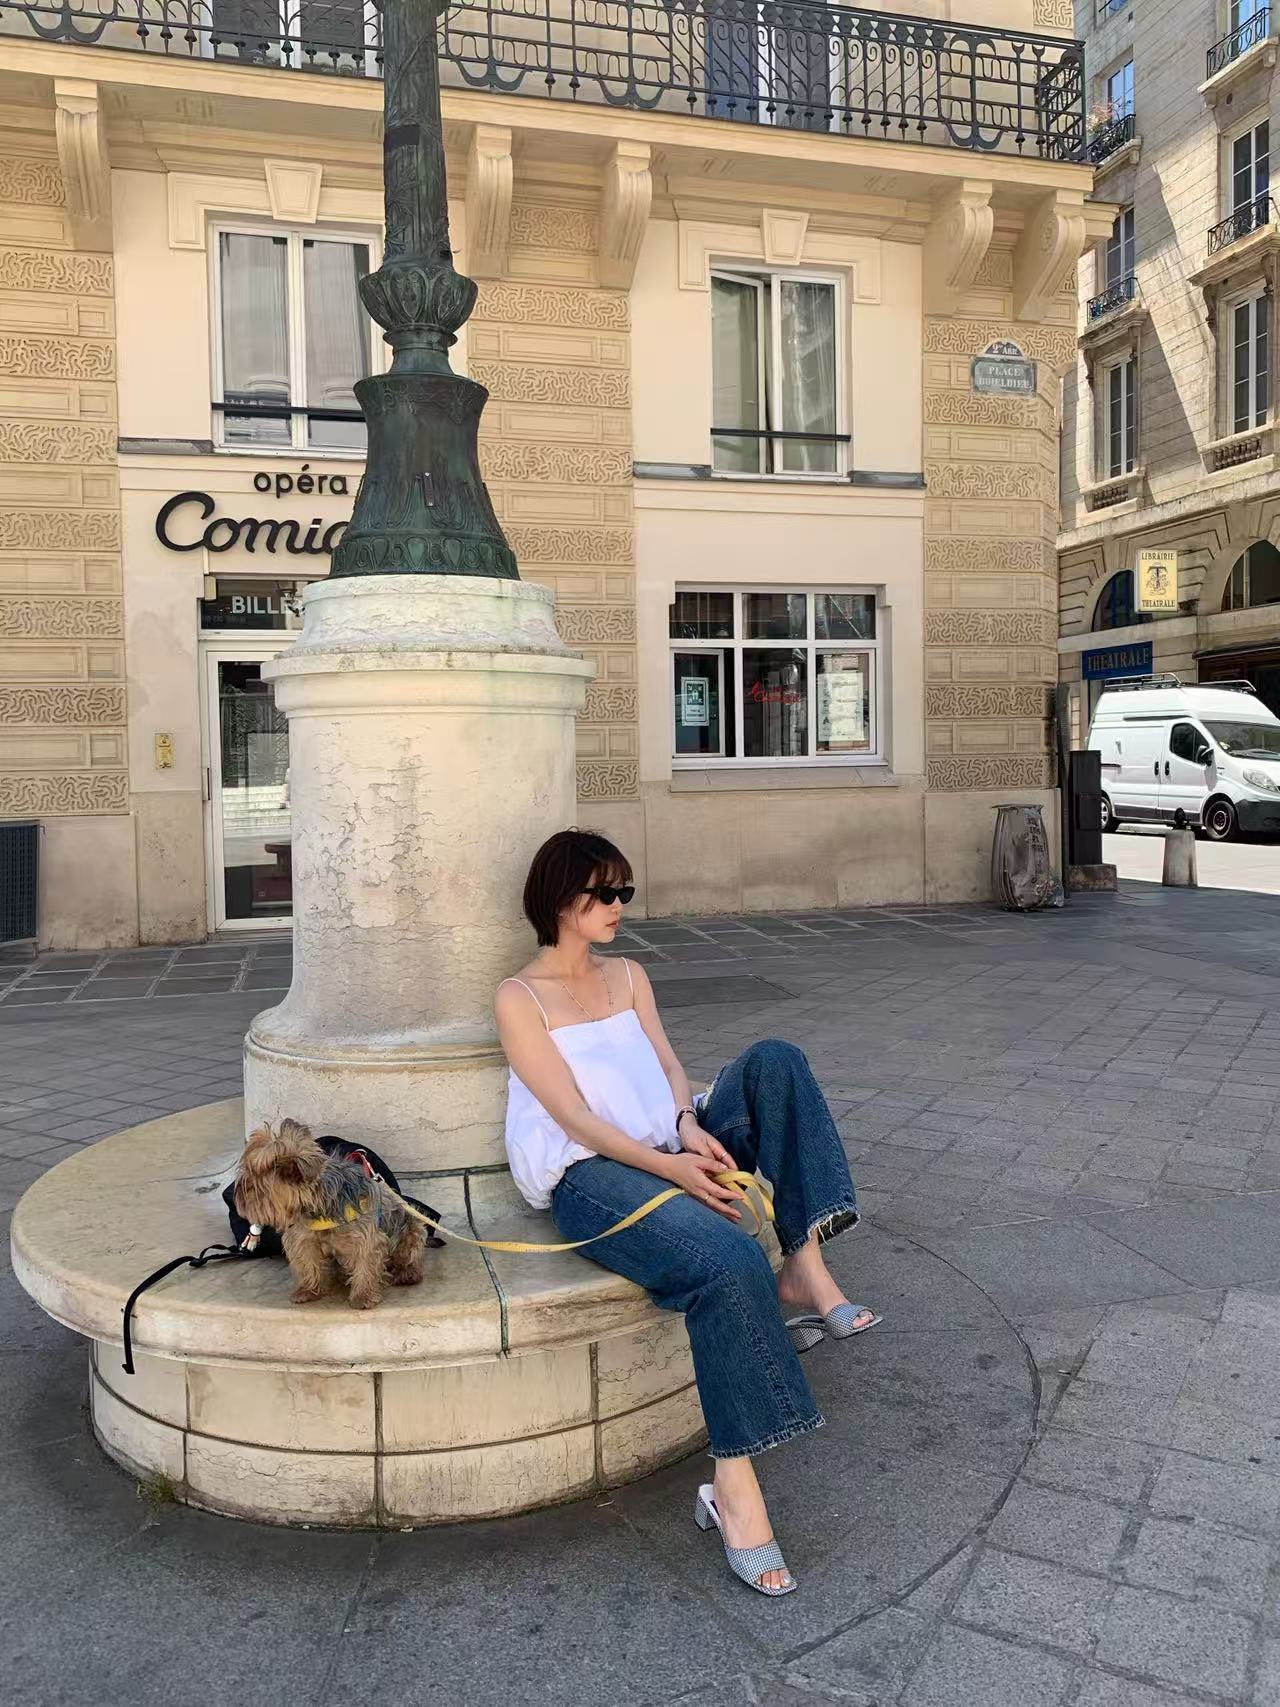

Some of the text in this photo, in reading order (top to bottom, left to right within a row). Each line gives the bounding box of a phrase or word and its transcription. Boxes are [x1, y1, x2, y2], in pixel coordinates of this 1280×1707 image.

[989, 367, 1021, 377] PLACE
[253, 464, 348, 499] opéra
[1141, 552, 1175, 561] LIBRAIRIE
